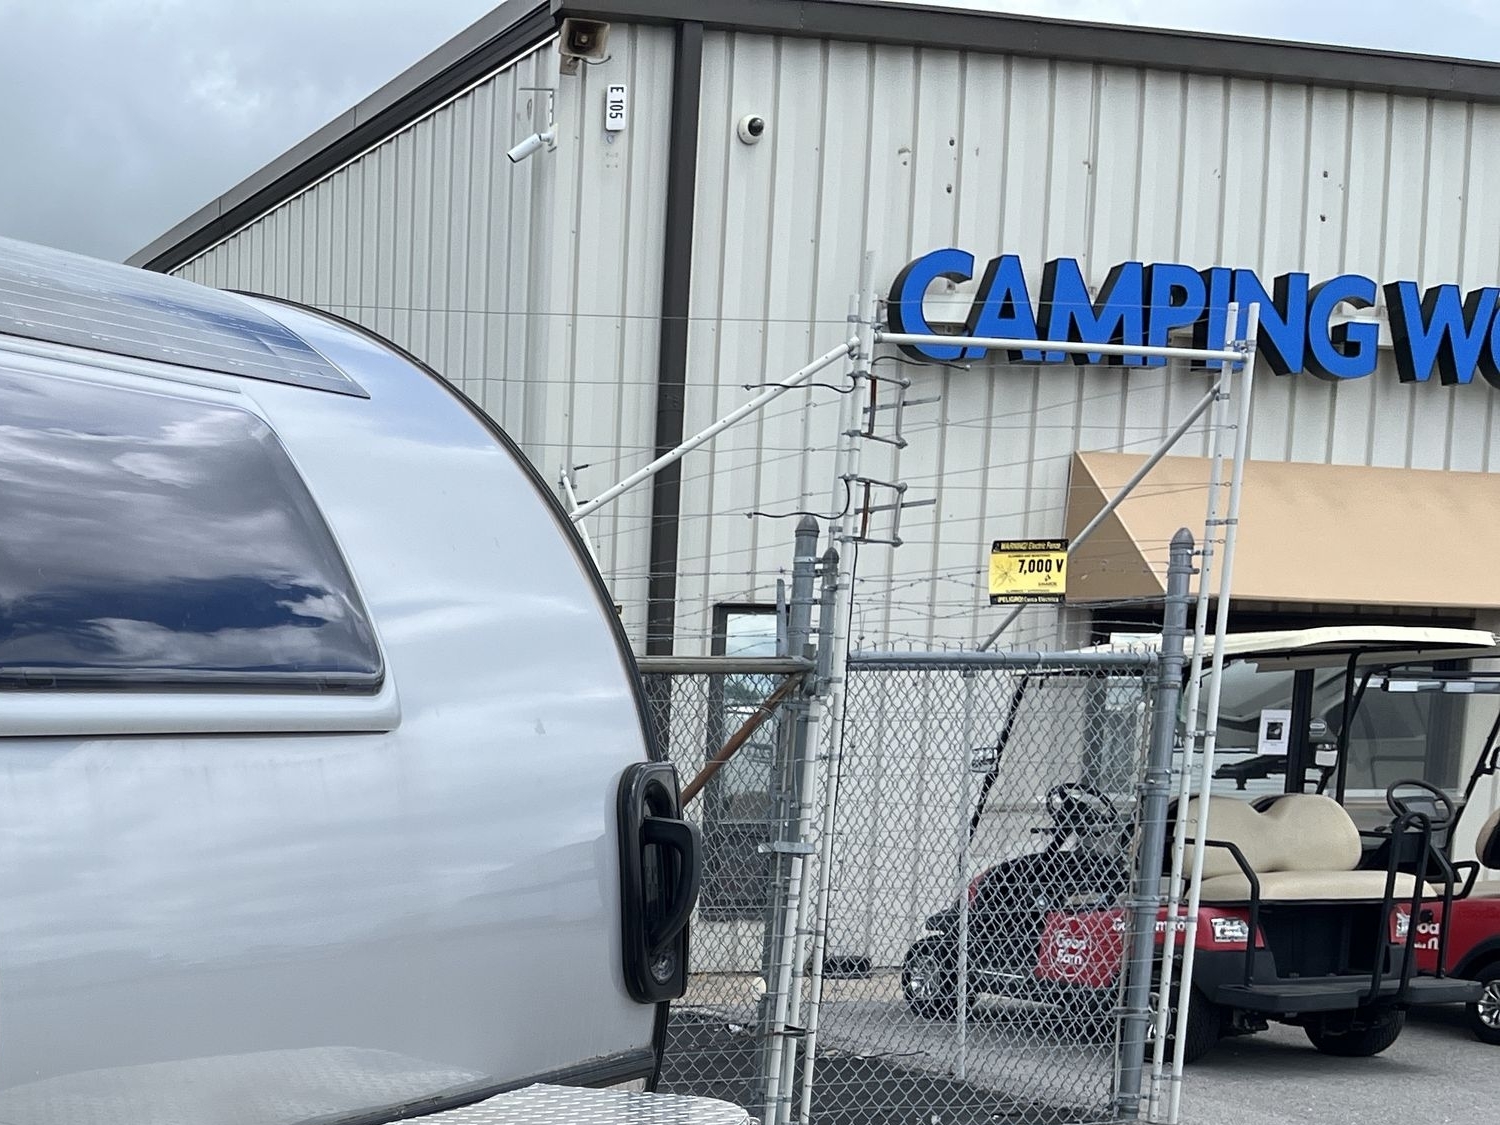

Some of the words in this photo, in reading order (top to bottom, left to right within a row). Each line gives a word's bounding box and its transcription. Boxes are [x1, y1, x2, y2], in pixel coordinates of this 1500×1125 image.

[609, 99, 623, 119] 105
[888, 248, 1379, 381] CAMPING
[1018, 558, 1052, 575] 7,000
[1056, 558, 1065, 573] V
